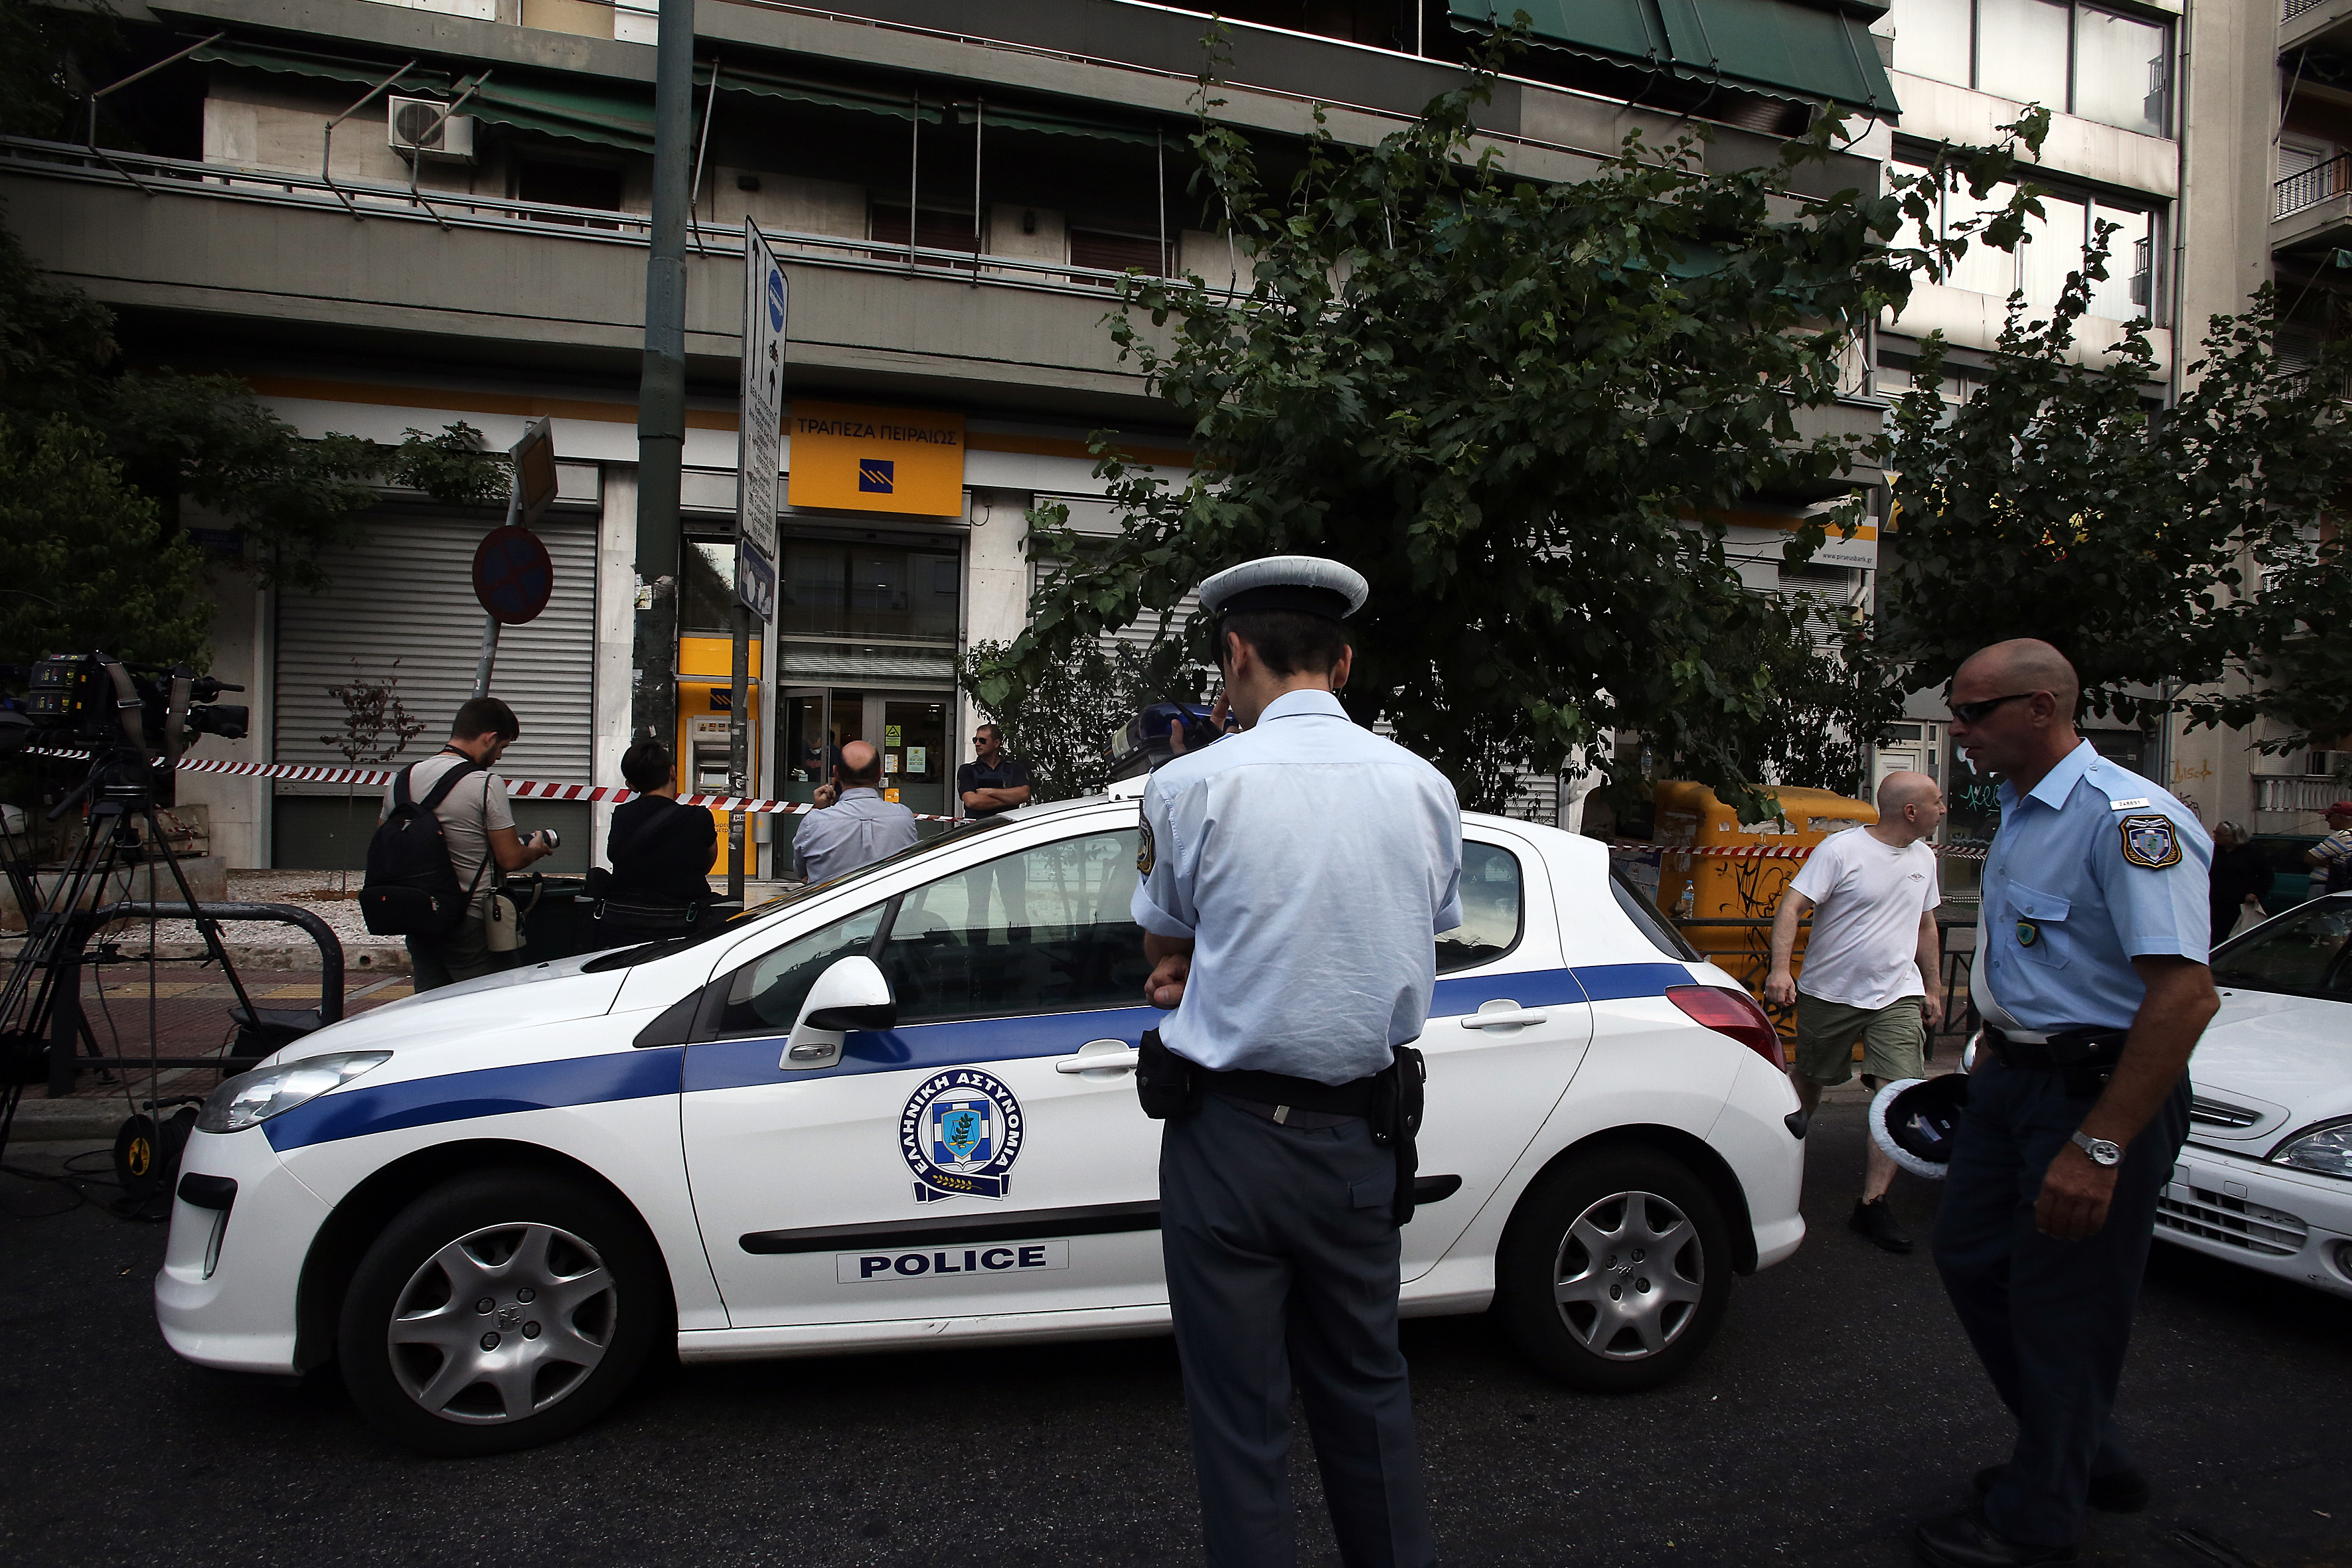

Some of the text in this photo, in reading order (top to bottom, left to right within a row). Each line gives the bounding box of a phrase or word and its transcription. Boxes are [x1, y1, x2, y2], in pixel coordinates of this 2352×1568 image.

[797, 418, 957, 445] ΤΡΑΠΕΖΑ ΠΕΙΡΑΙΩΣ
[1822, 552, 1873, 564] www.piraeusbank.gr
[902, 1072, 1020, 1174] ΕΛΛΗΝΙΚΗ ΑΣΤΥΝΟΜΙΑ
[860, 1245, 1047, 1279] POLICE
